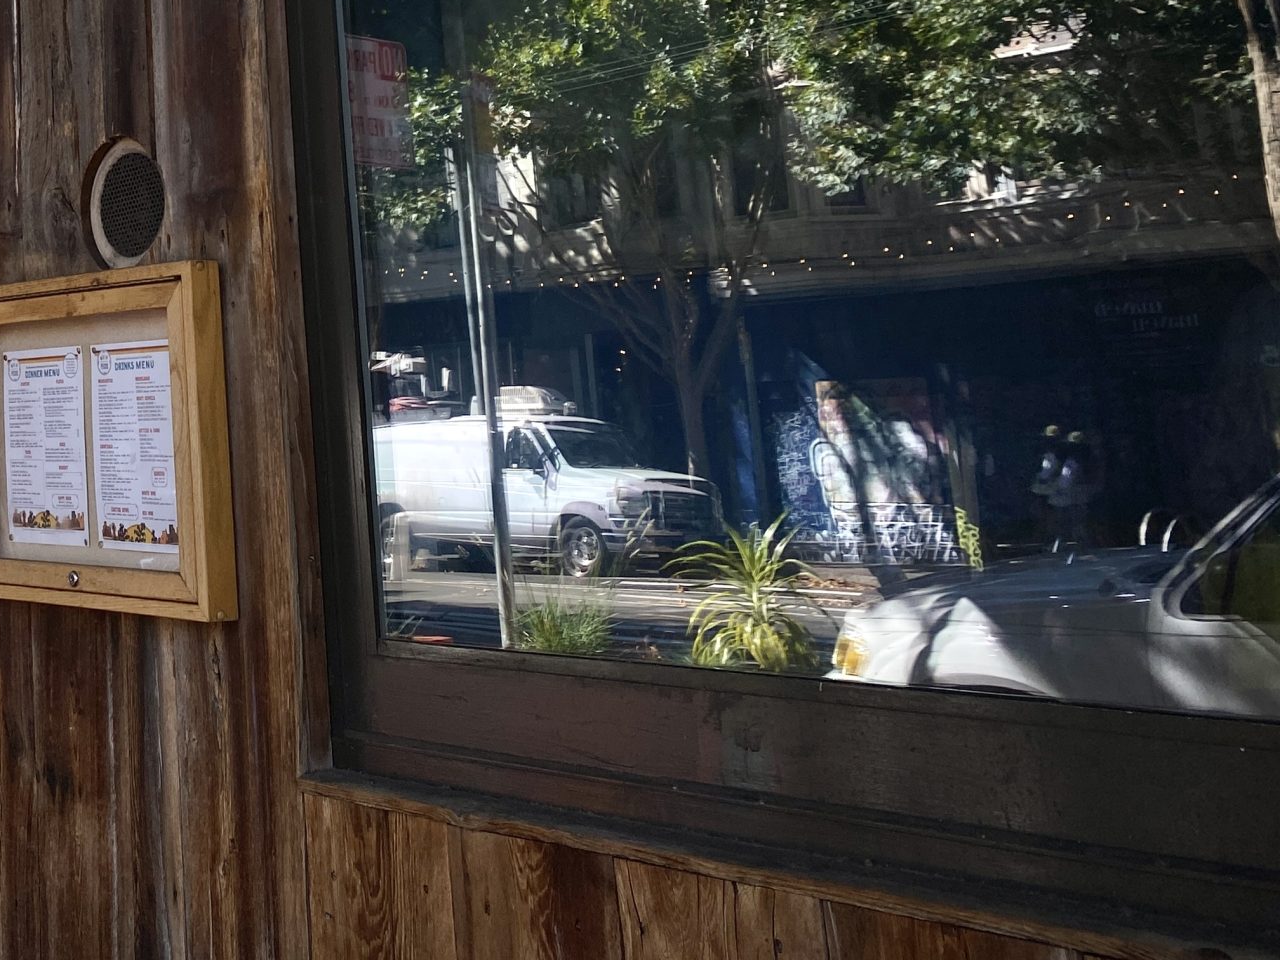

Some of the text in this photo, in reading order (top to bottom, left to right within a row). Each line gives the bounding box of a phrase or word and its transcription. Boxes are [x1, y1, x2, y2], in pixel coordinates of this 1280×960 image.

[114, 362, 135, 371] DRINKS
[135, 360, 155, 370] MENU
[24, 369, 43, 379] DINNER
[43, 368, 60, 377] MENU
